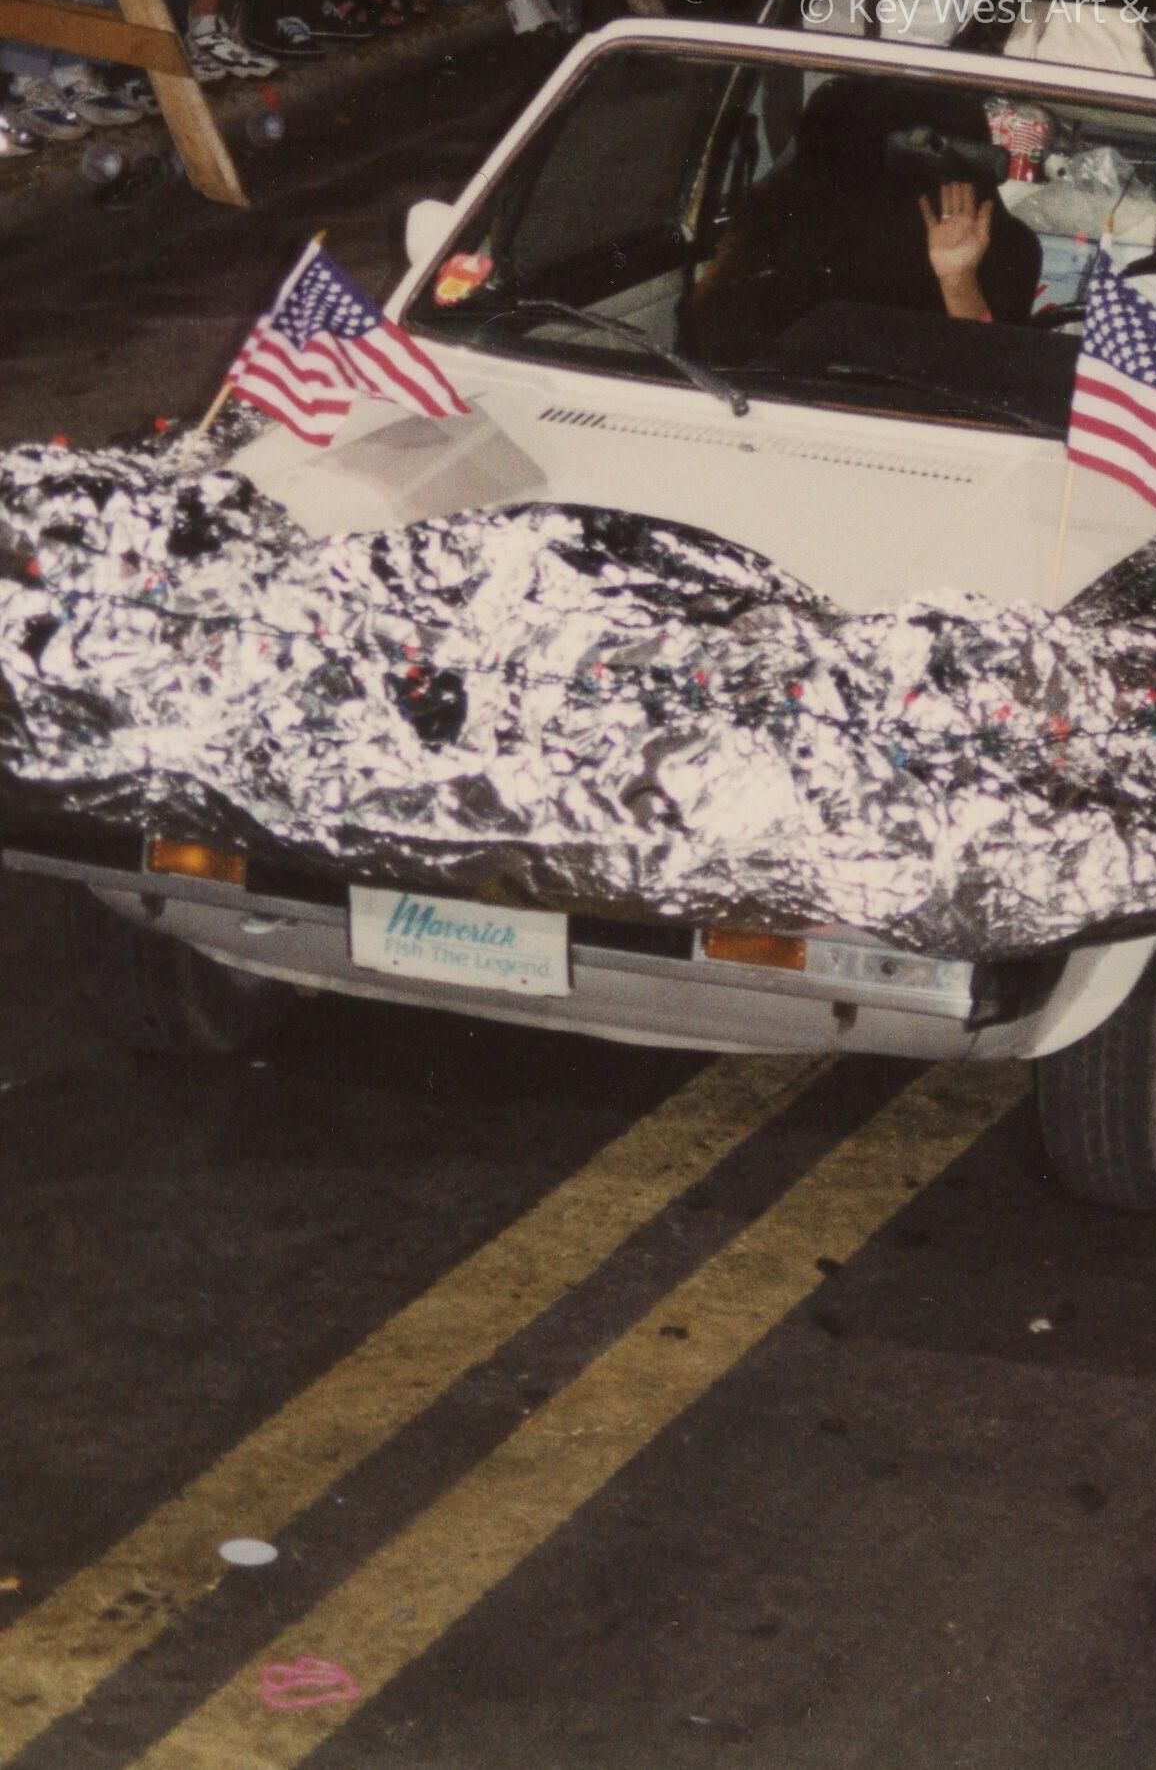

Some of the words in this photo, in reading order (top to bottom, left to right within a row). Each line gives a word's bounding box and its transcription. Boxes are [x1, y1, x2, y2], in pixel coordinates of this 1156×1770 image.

[384, 892, 517, 947] Maverick
[431, 945, 469, 968] The
[475, 952, 553, 979] Legend
